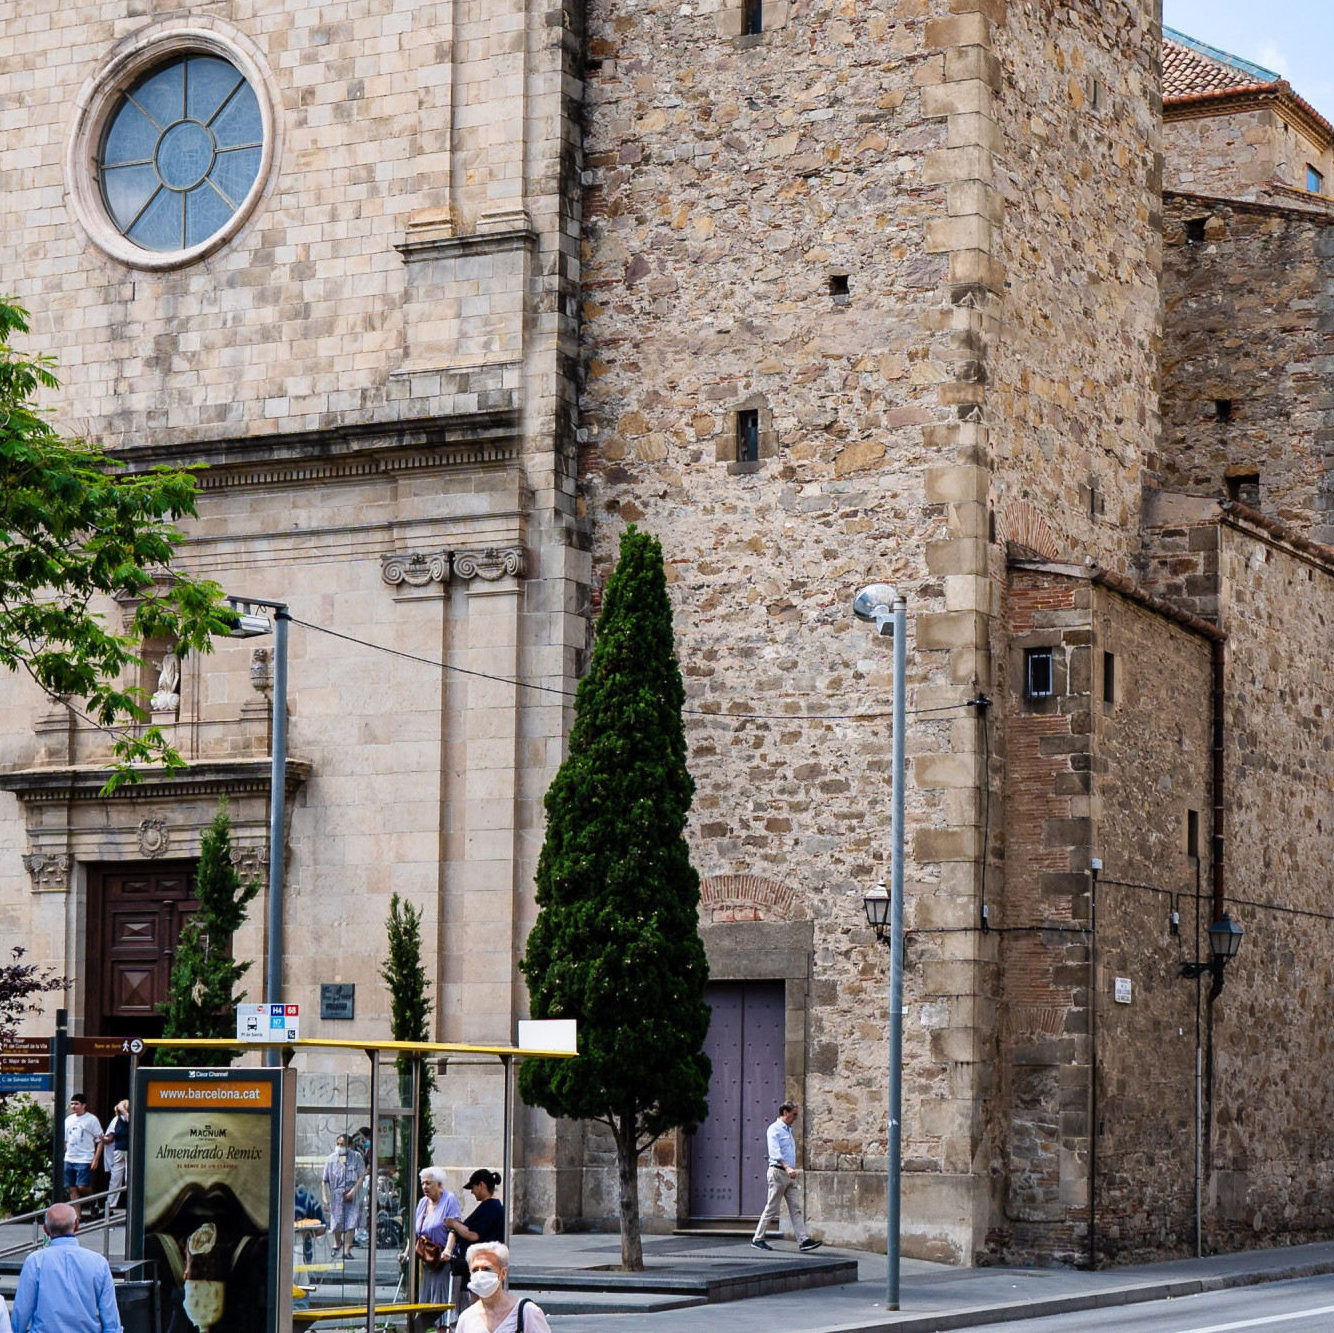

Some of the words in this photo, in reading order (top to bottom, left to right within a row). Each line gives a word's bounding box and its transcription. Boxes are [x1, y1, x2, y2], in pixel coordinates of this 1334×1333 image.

[272, 1006, 283, 1014] H4
[287, 1006, 297, 1014] 68
[160, 1088, 260, 1099] www.barcelona.cat
[189, 1128, 227, 1138] MAGNUM
[155, 1144, 224, 1160] Almendrado
[226, 1146, 262, 1160] Remix
